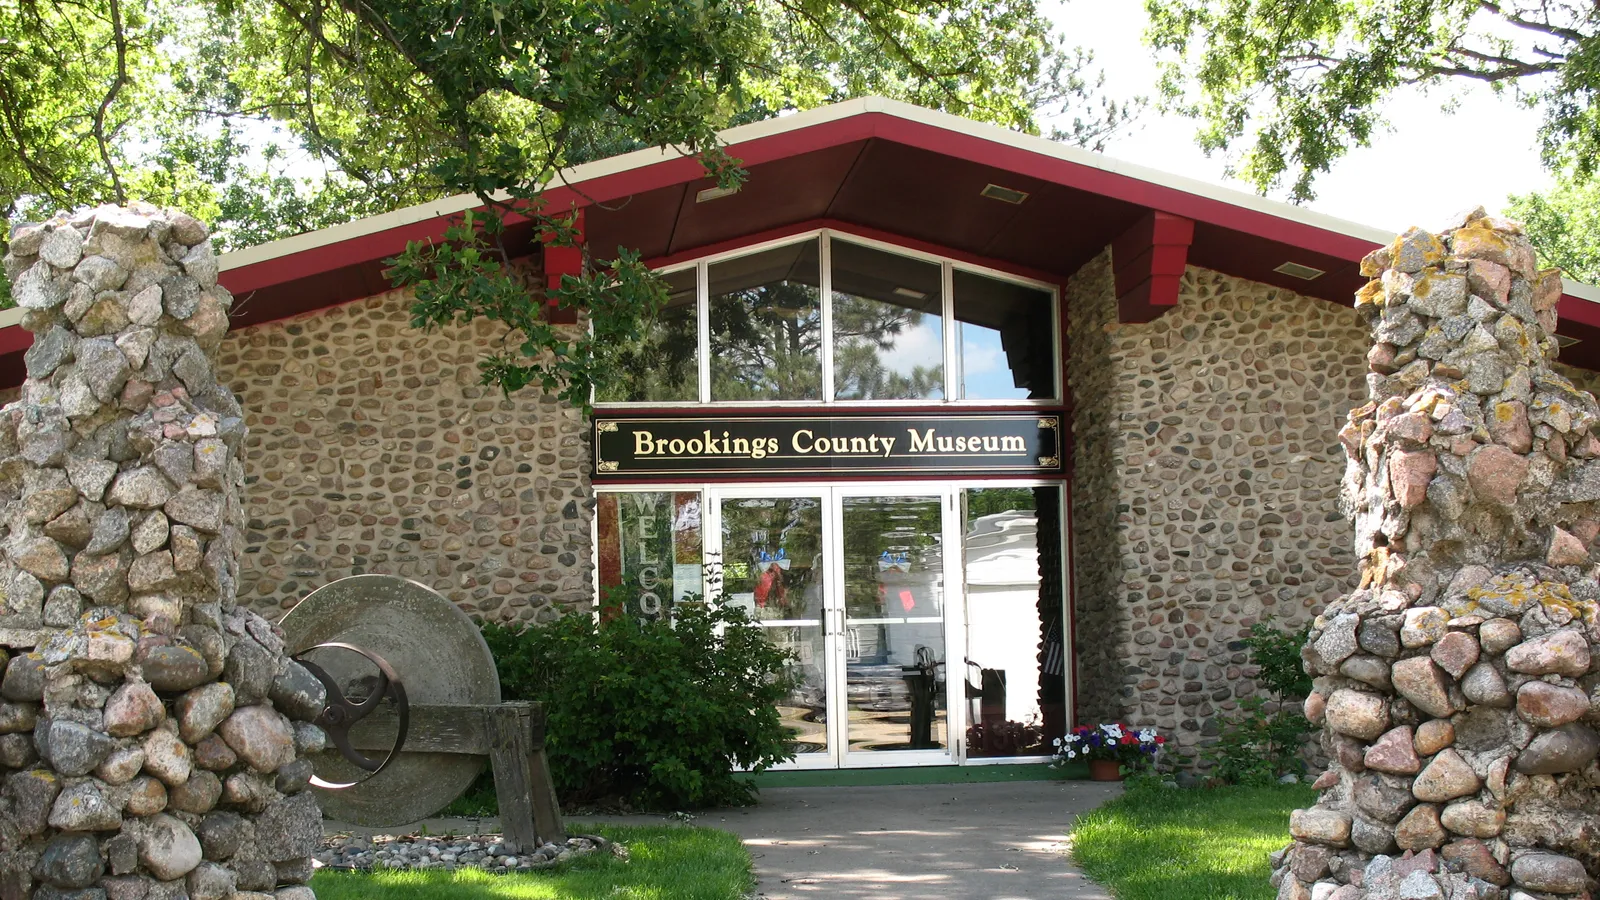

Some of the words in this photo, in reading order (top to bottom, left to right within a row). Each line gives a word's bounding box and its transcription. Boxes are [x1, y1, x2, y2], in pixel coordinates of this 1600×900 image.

[632, 430, 779, 459] Brookings
[791, 429, 896, 457] County
[907, 428, 1027, 453] Museum
